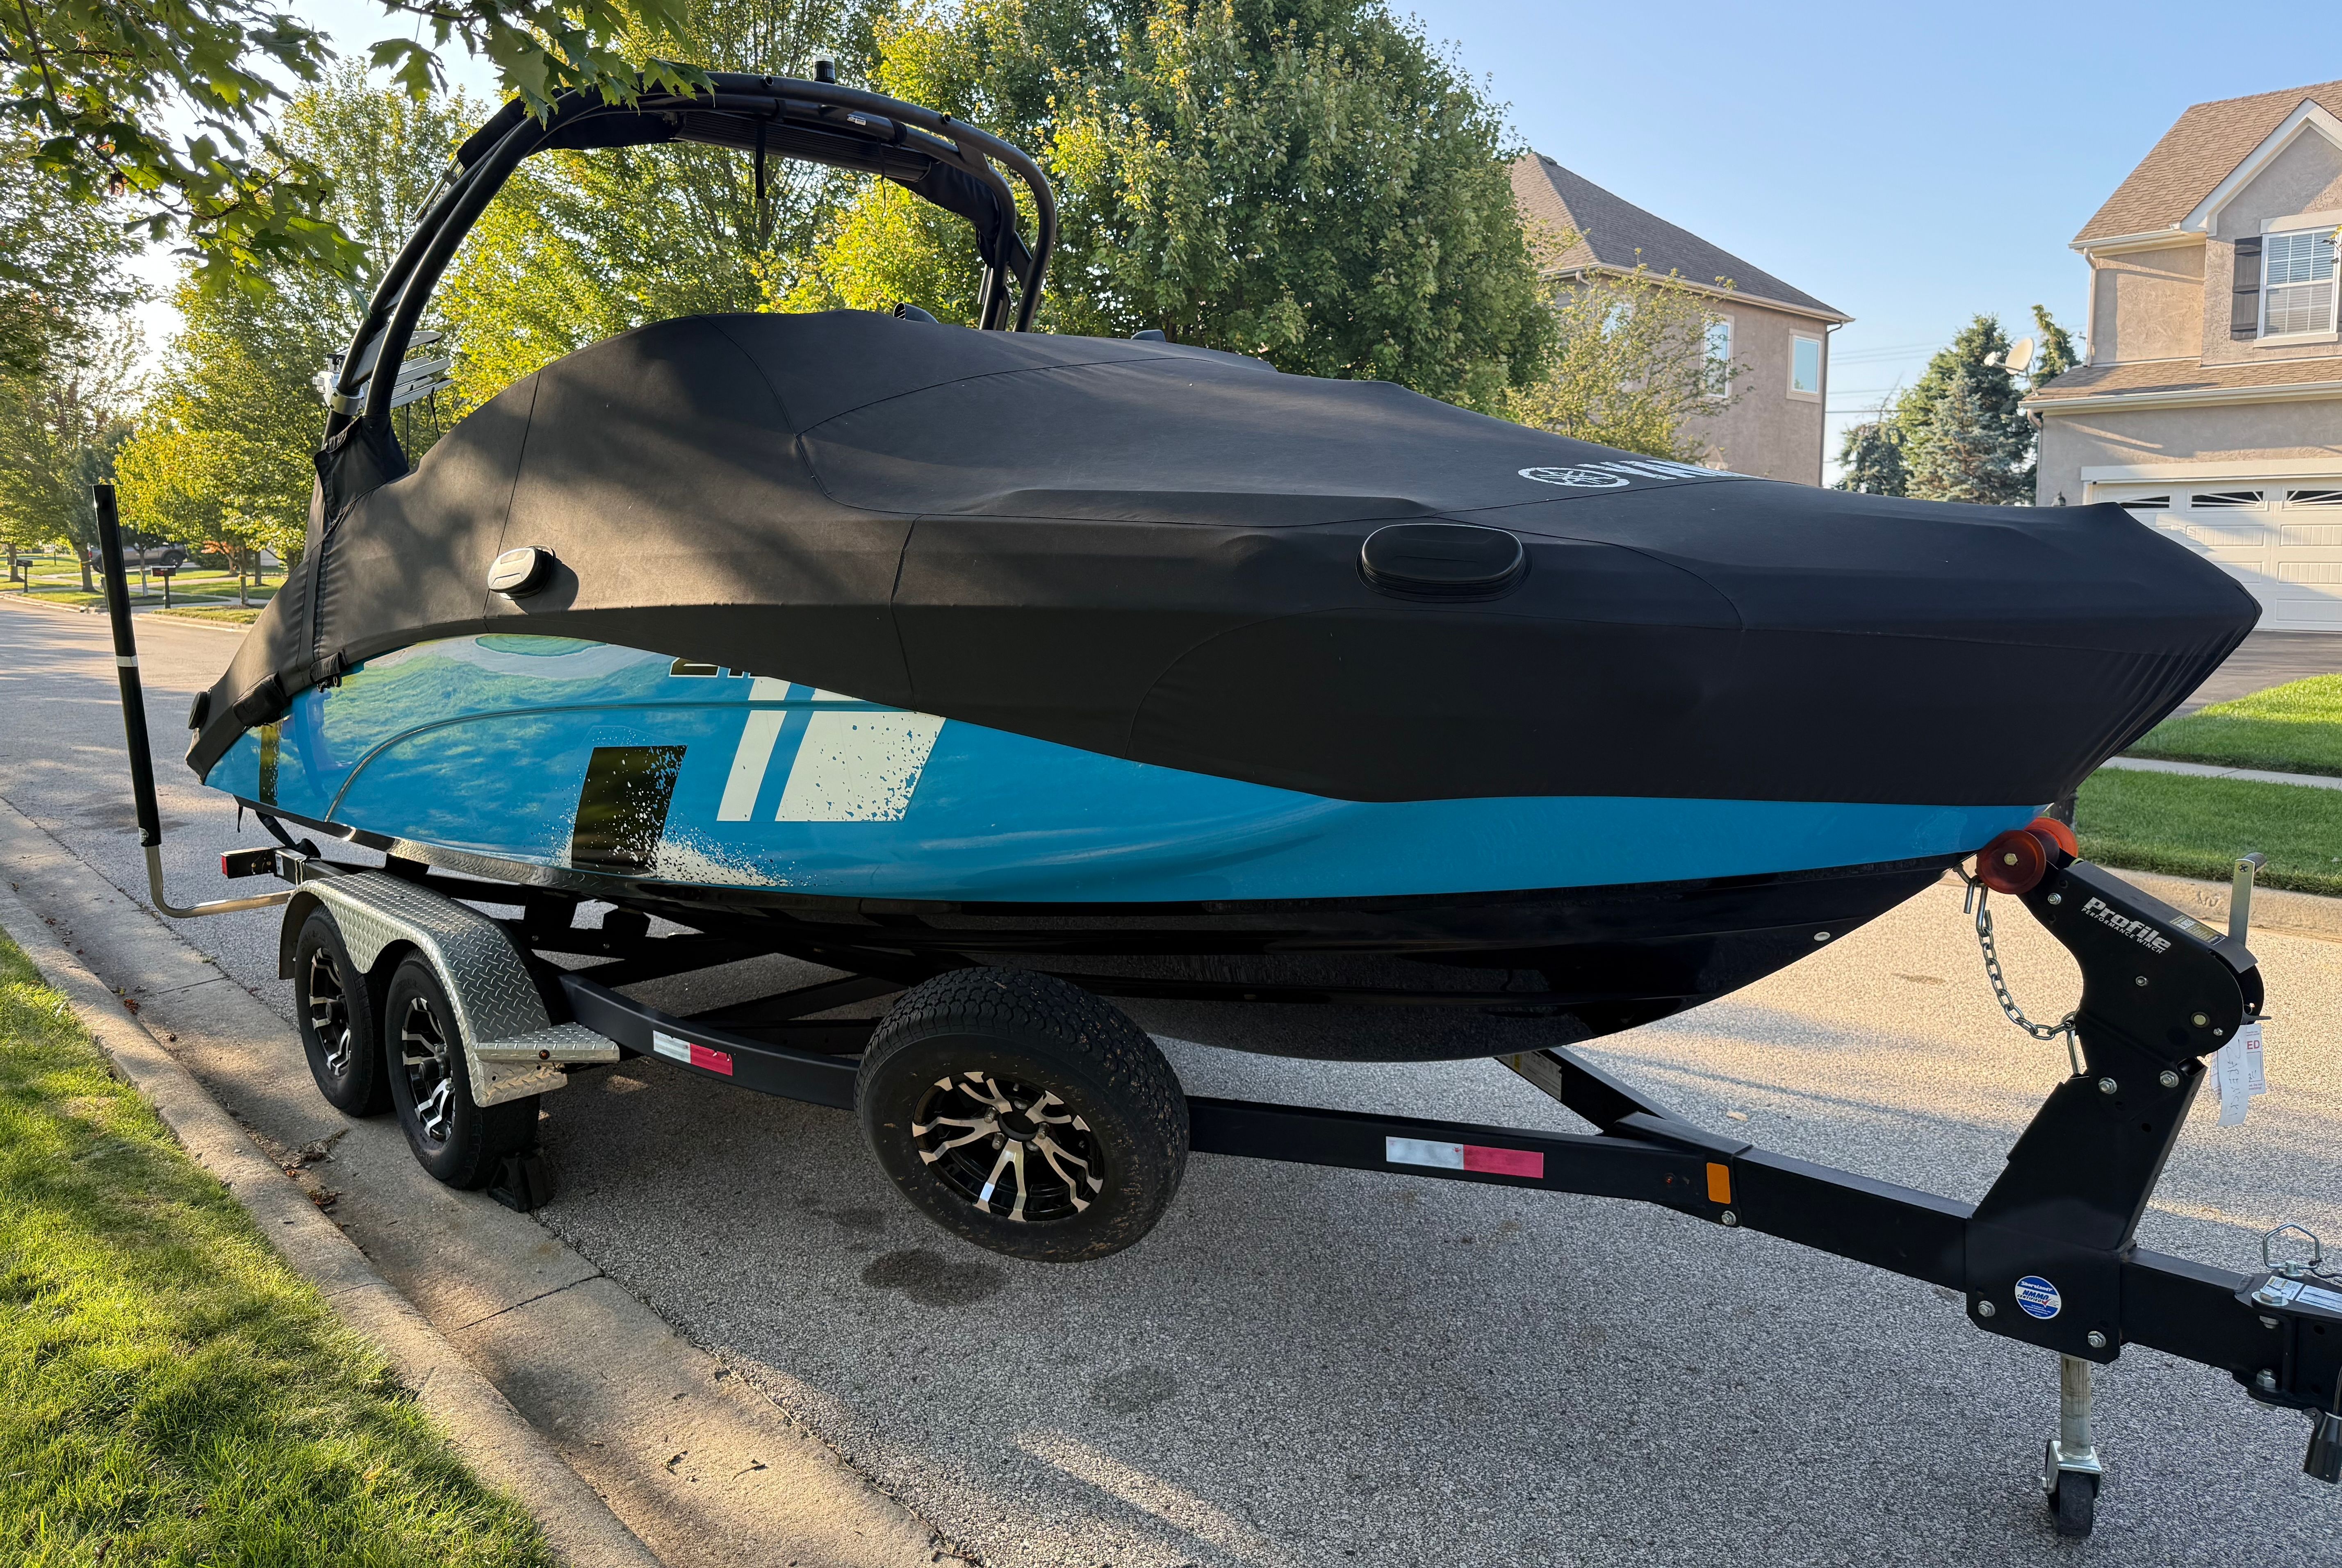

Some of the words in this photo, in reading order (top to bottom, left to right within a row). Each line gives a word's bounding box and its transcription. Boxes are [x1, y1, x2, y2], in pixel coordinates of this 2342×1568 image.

[2081, 908, 2135, 939] PERFORMANCE
[2136, 937, 2163, 954] WINCH
[2084, 897, 2171, 951] Profile
[2017, 1294, 2041, 1302] CERTIFIED
